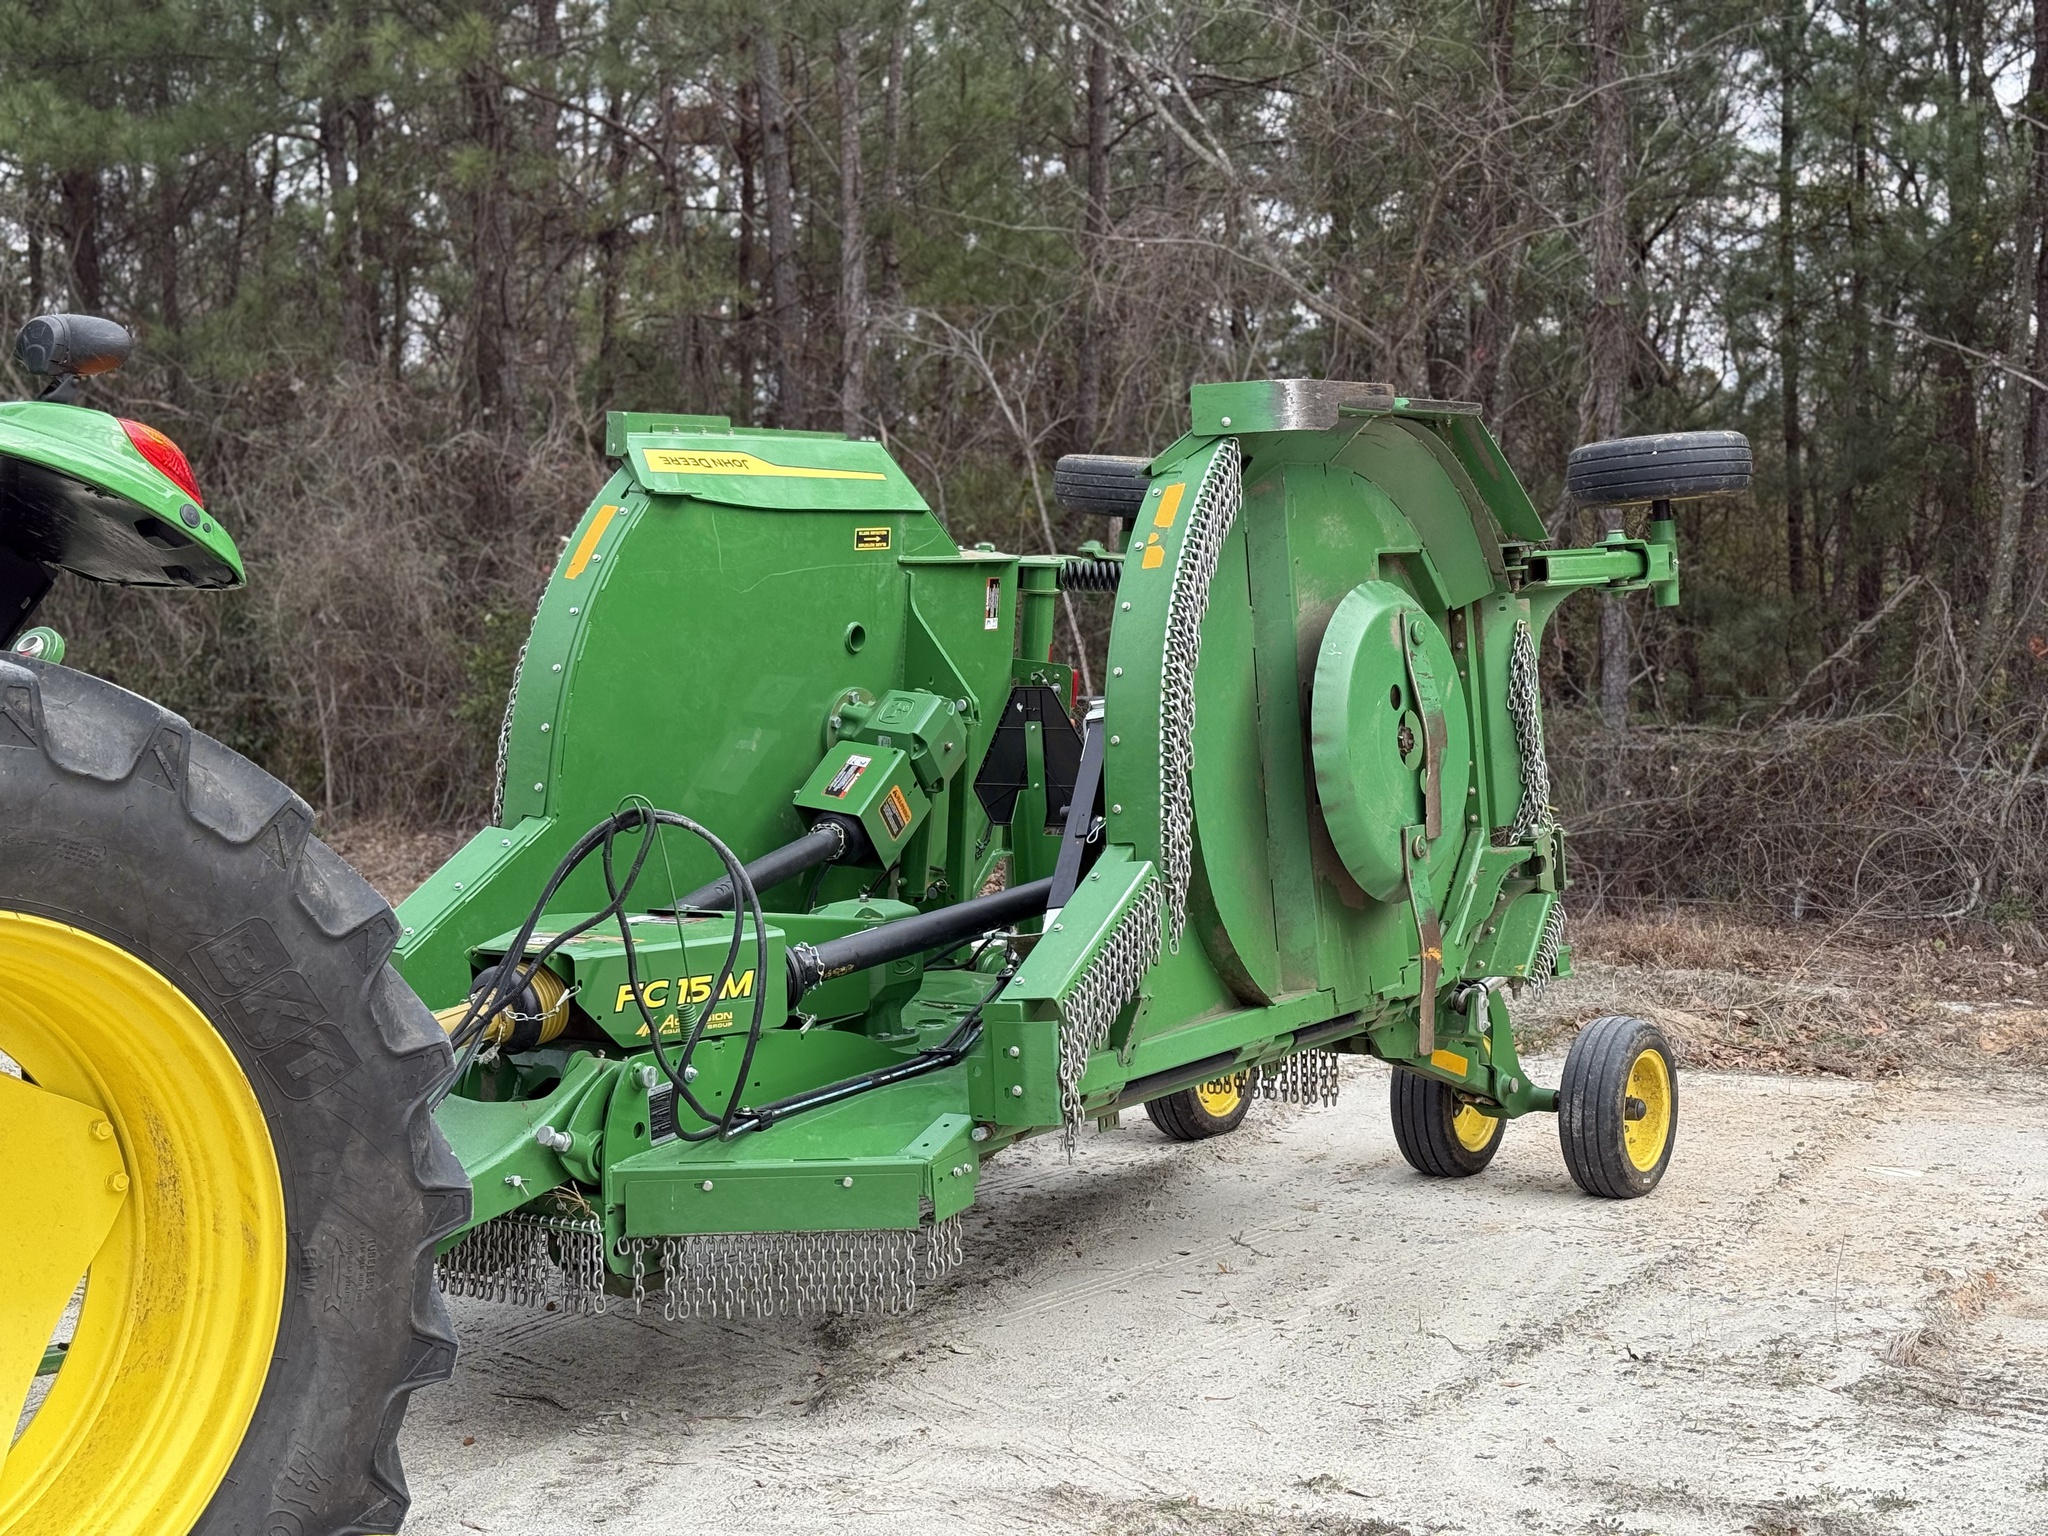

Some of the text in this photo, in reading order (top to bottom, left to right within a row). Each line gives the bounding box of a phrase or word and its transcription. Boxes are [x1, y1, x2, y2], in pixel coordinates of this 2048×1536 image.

[658, 456, 750, 470] JOHN DEERE
[204, 924, 347, 1083] BKT
[707, 1022, 733, 1030] GROUP
